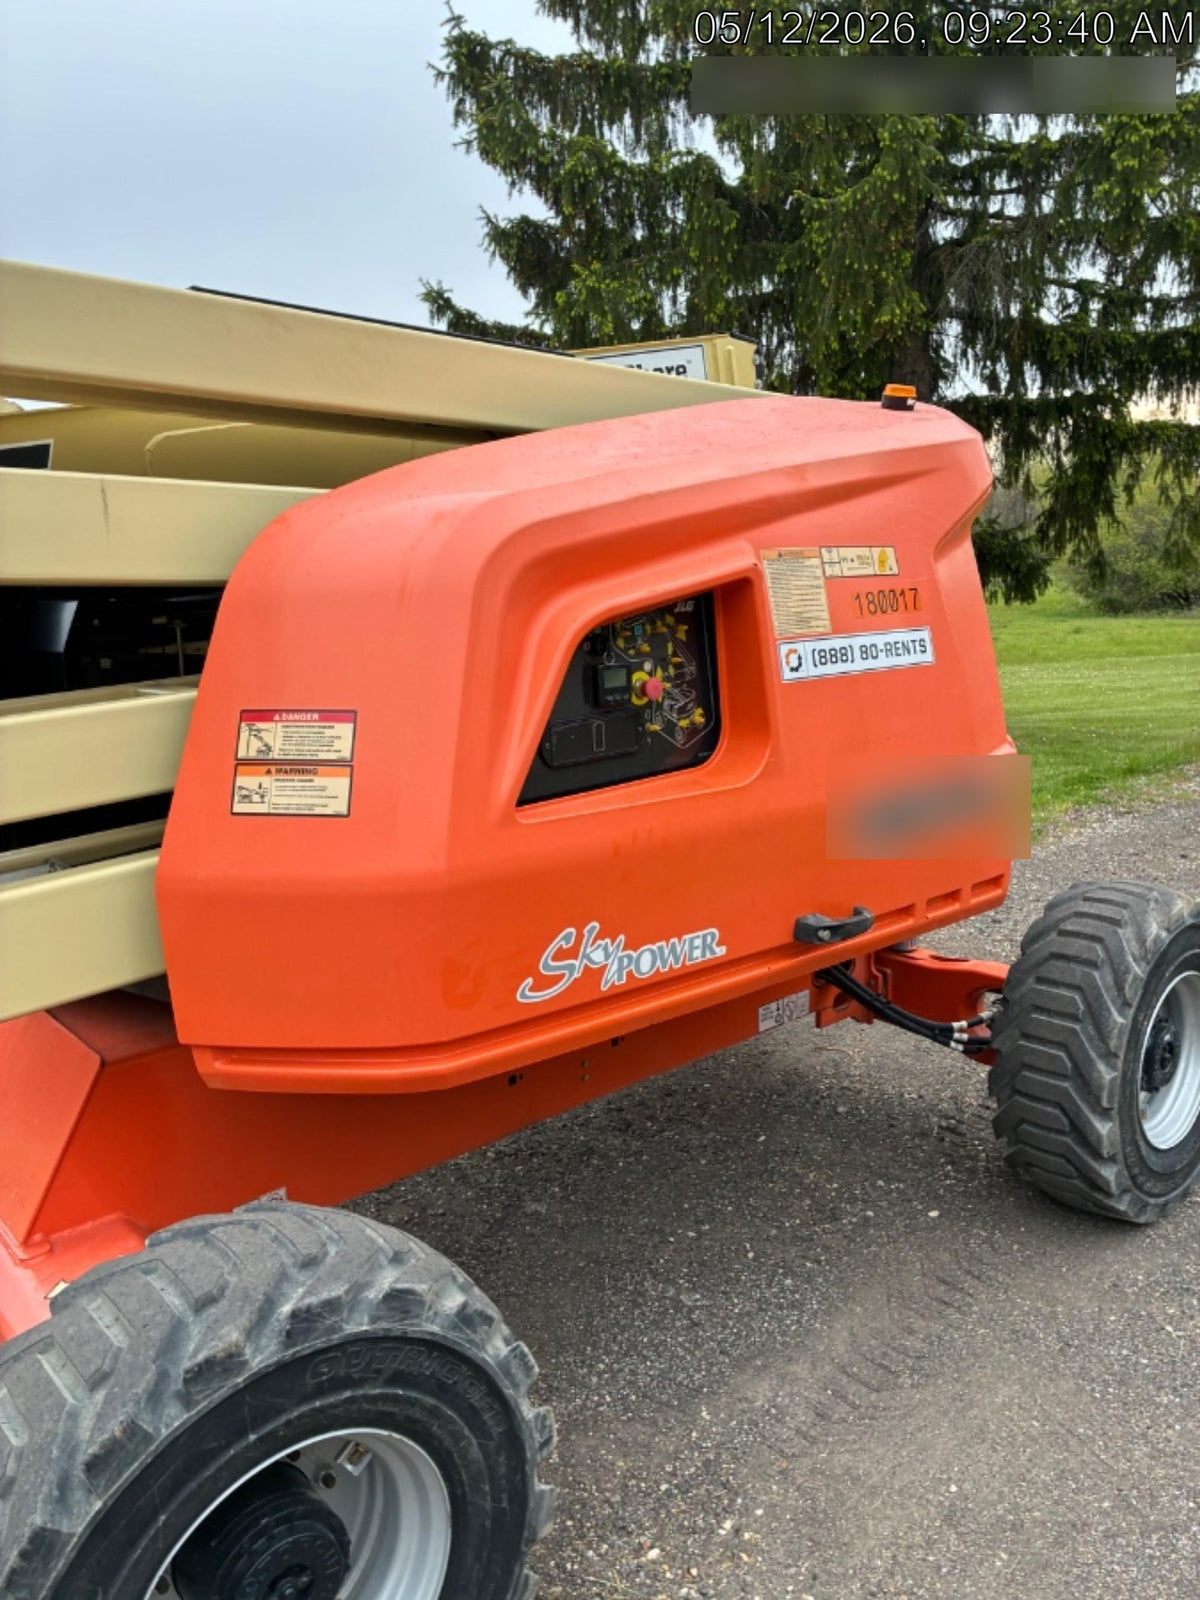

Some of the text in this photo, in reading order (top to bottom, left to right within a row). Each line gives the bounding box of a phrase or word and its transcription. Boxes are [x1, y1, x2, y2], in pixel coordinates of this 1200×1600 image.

[854, 587, 919, 616] 180017
[811, 638, 928, 668] (888) 80-RENTS
[281, 712, 320, 721] DANGER
[274, 767, 319, 776] WARNING
